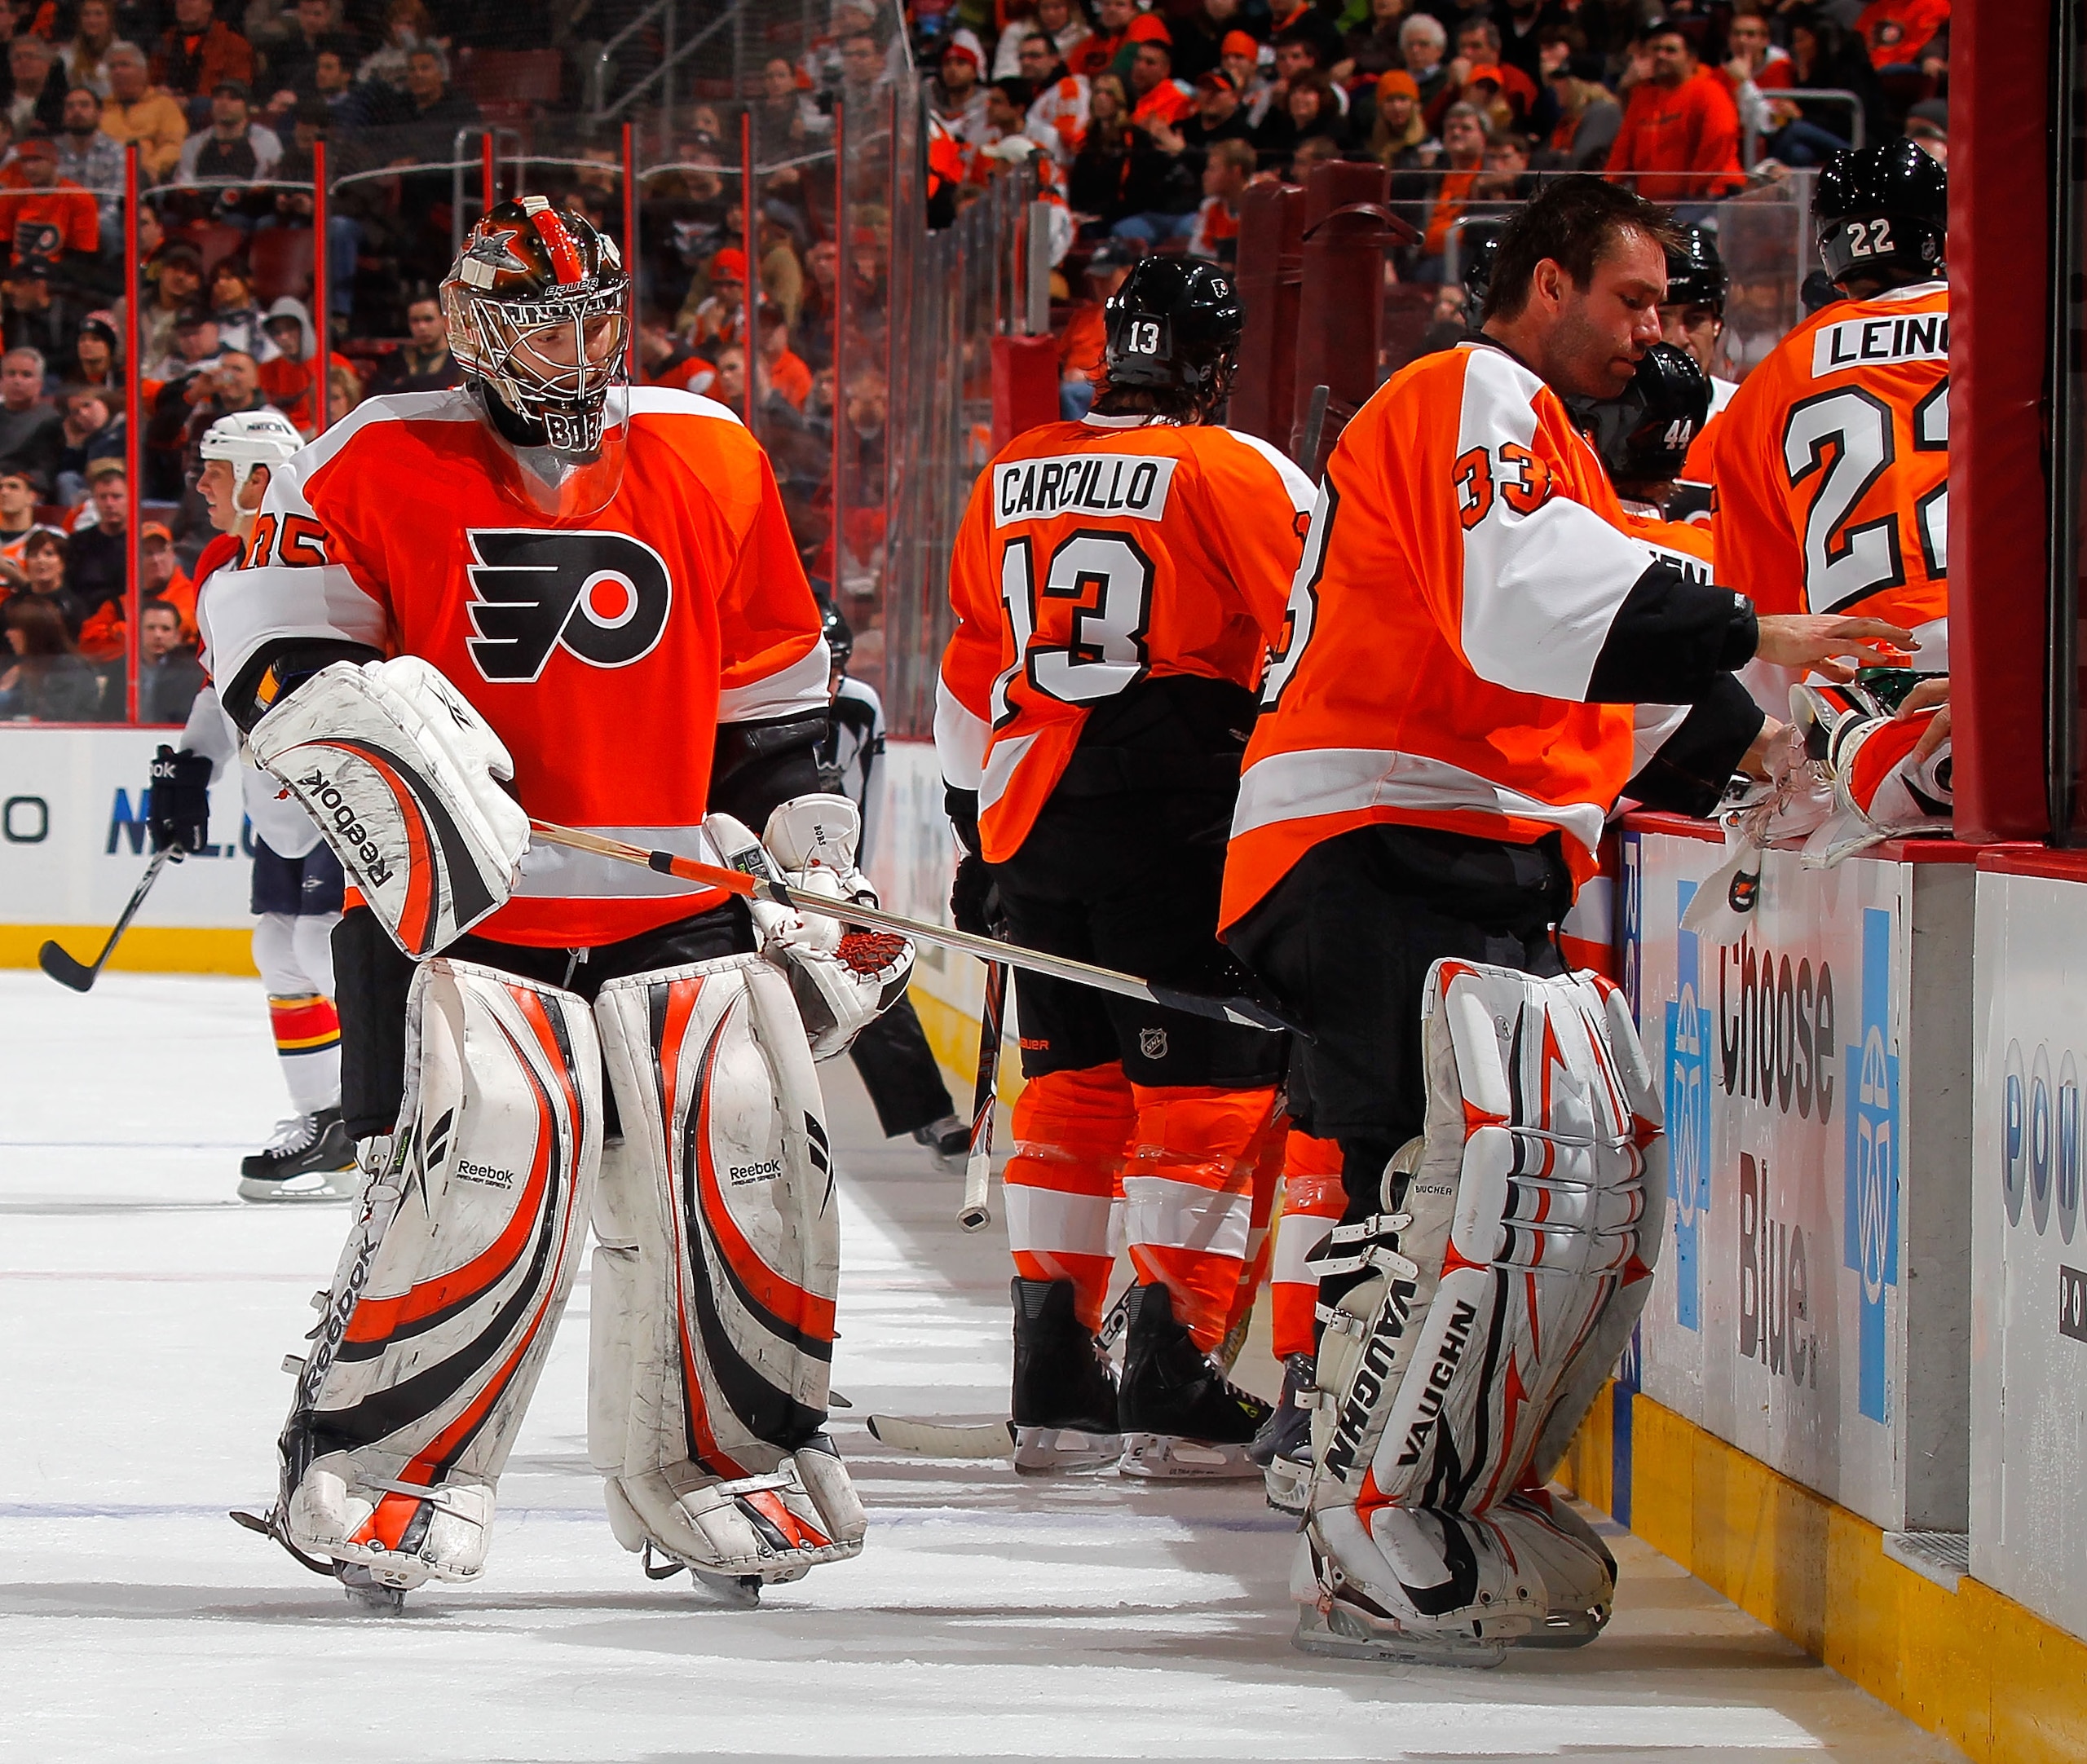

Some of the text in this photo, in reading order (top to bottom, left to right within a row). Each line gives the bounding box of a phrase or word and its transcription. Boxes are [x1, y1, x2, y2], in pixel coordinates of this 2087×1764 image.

[1847, 218, 1895, 257] 22
[1129, 321, 1159, 354] 13
[1831, 315, 1949, 366] LEIN
[1664, 419, 1692, 449] 44
[1002, 460, 1158, 517] CARCILLO
[1450, 441, 1551, 531] 33
[1648, 549, 1709, 587] EN
[991, 527, 1156, 734] 13
[297, 769, 395, 889] Reebok
[814, 825, 827, 846] BOBS
[1720, 928, 1835, 1127] Choose
[458, 1160, 514, 1184] Reebok
[730, 1159, 781, 1180] Reebok
[1415, 1184, 1453, 1196] BUCHER
[1326, 1278, 1417, 1484] VAUGHN
[1397, 1299, 1477, 1466] VAUGHN
